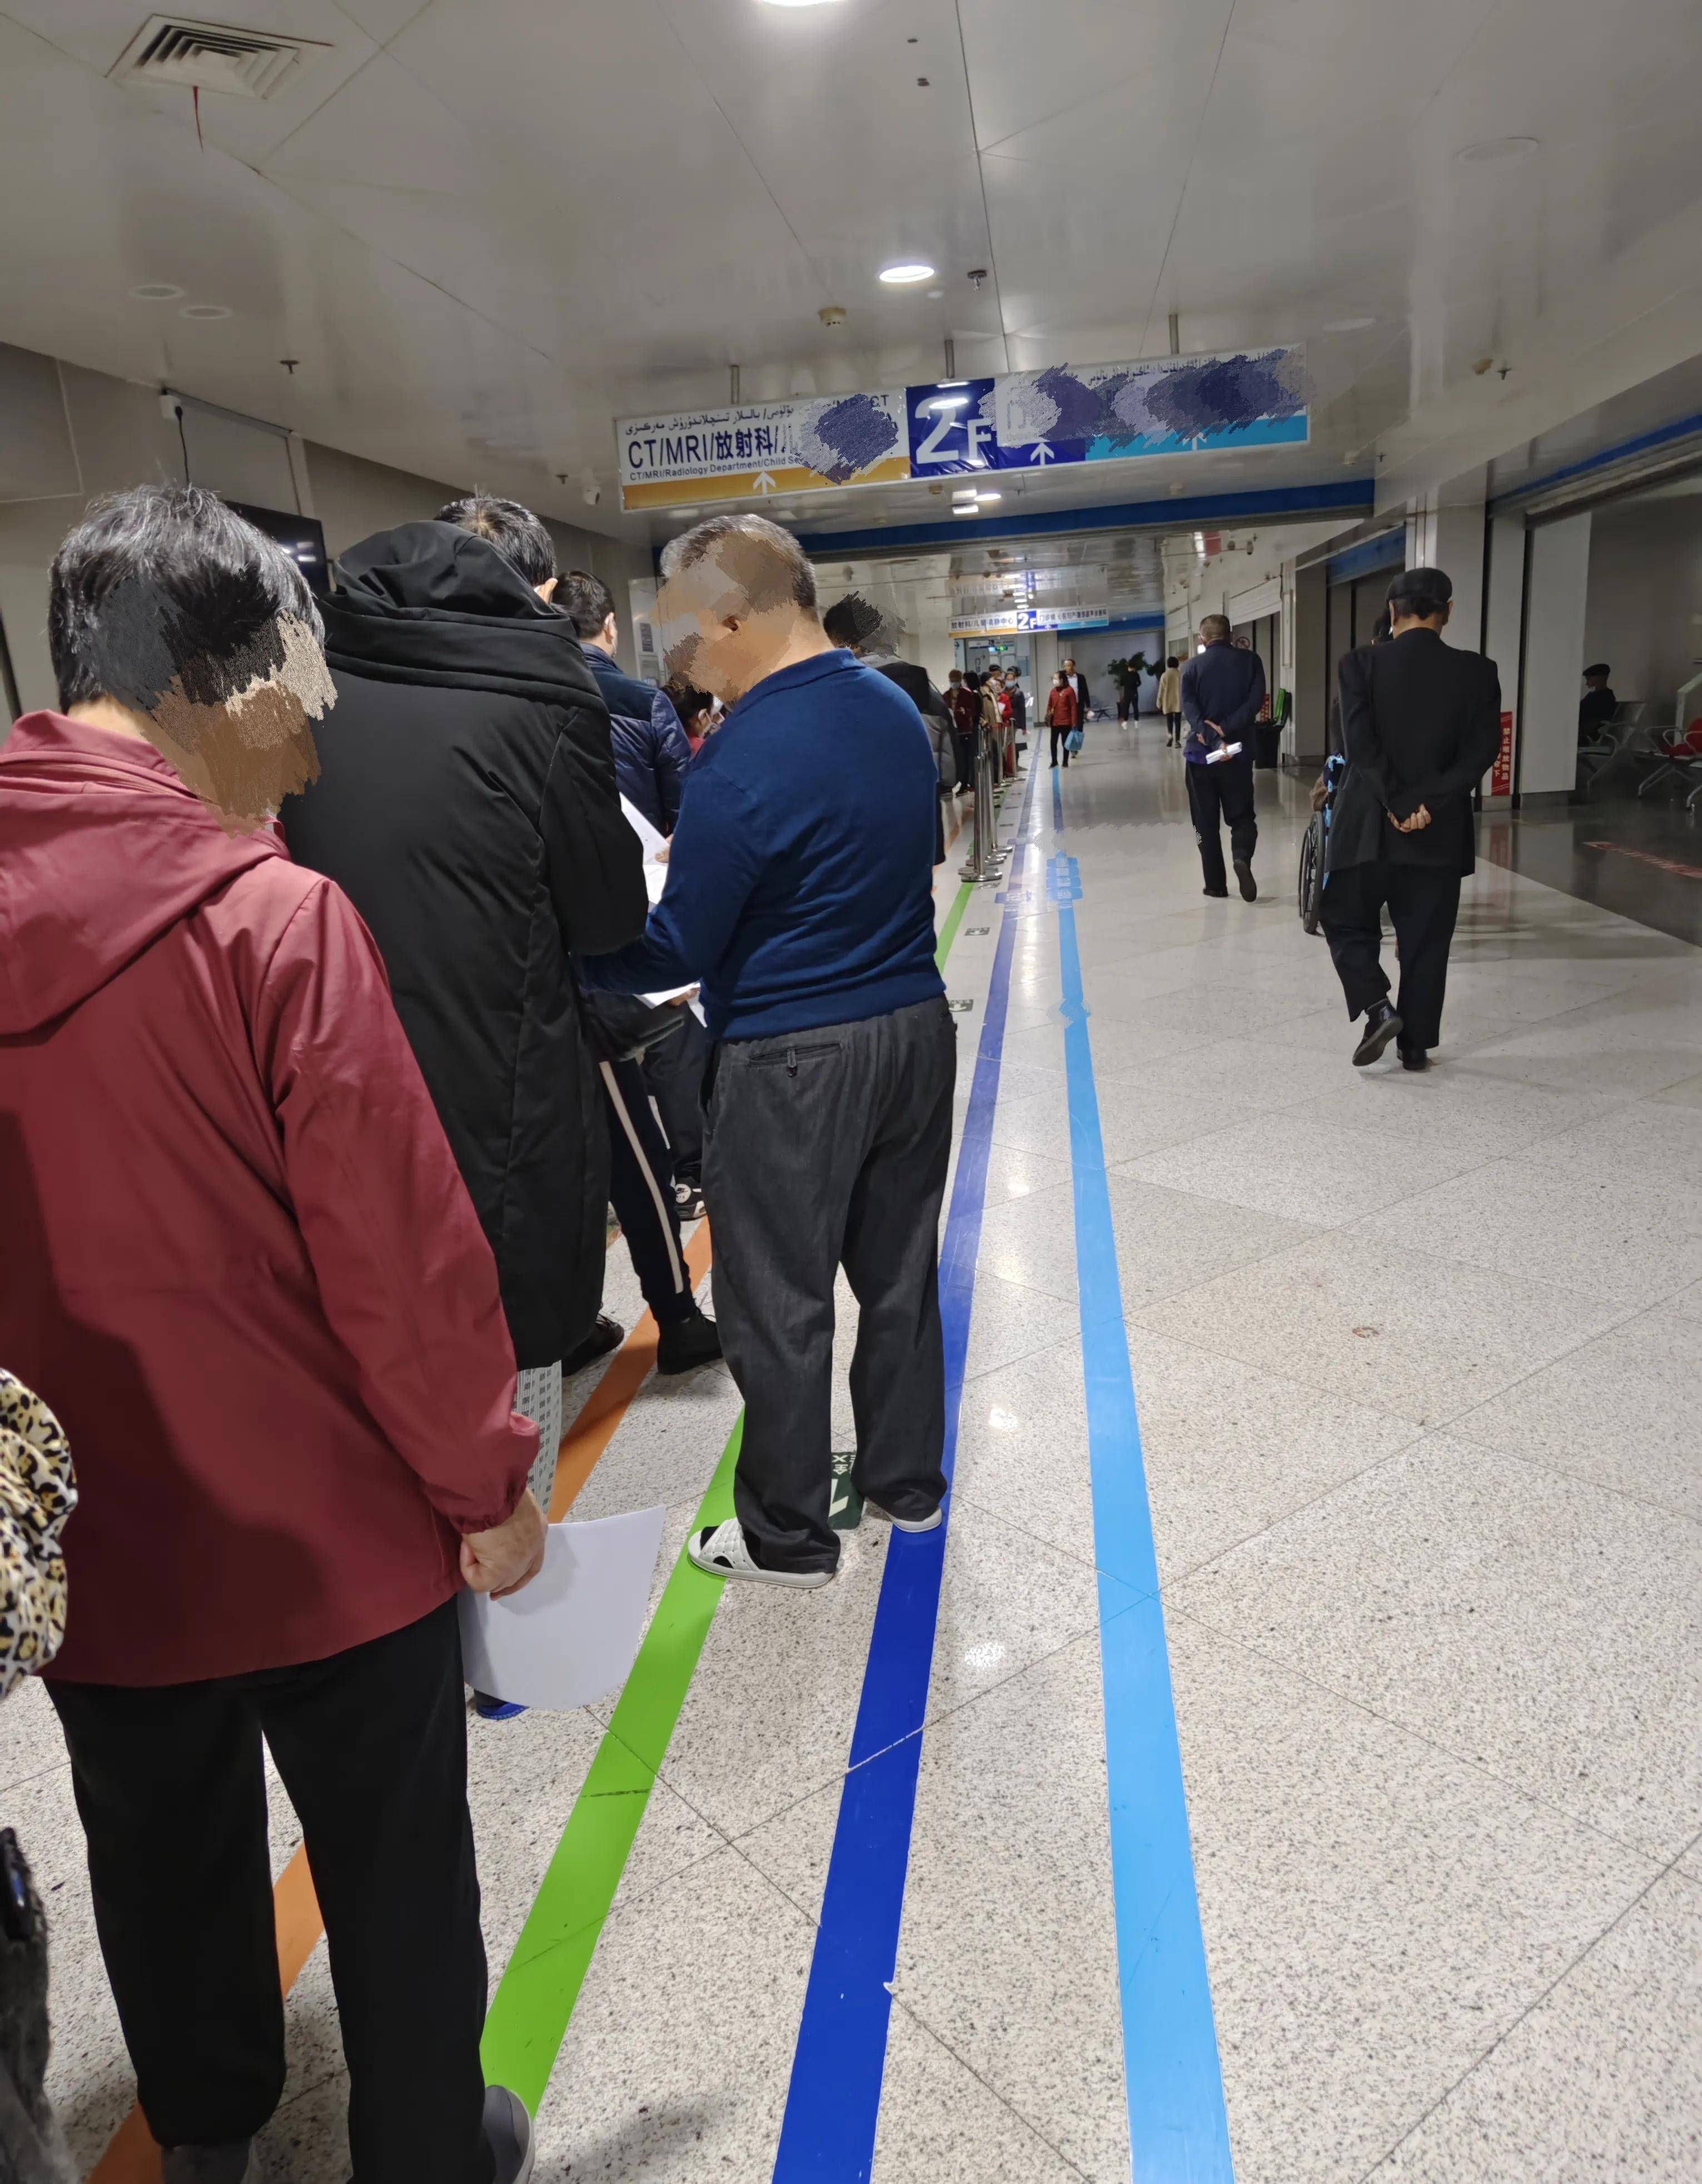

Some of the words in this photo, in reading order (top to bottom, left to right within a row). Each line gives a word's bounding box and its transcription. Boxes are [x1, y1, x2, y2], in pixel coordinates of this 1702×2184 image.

[630, 467, 707, 481] CT/MRI/Radiology
[710, 455, 785, 473] Department/Child
[1018, 613, 1037, 630] 2F
